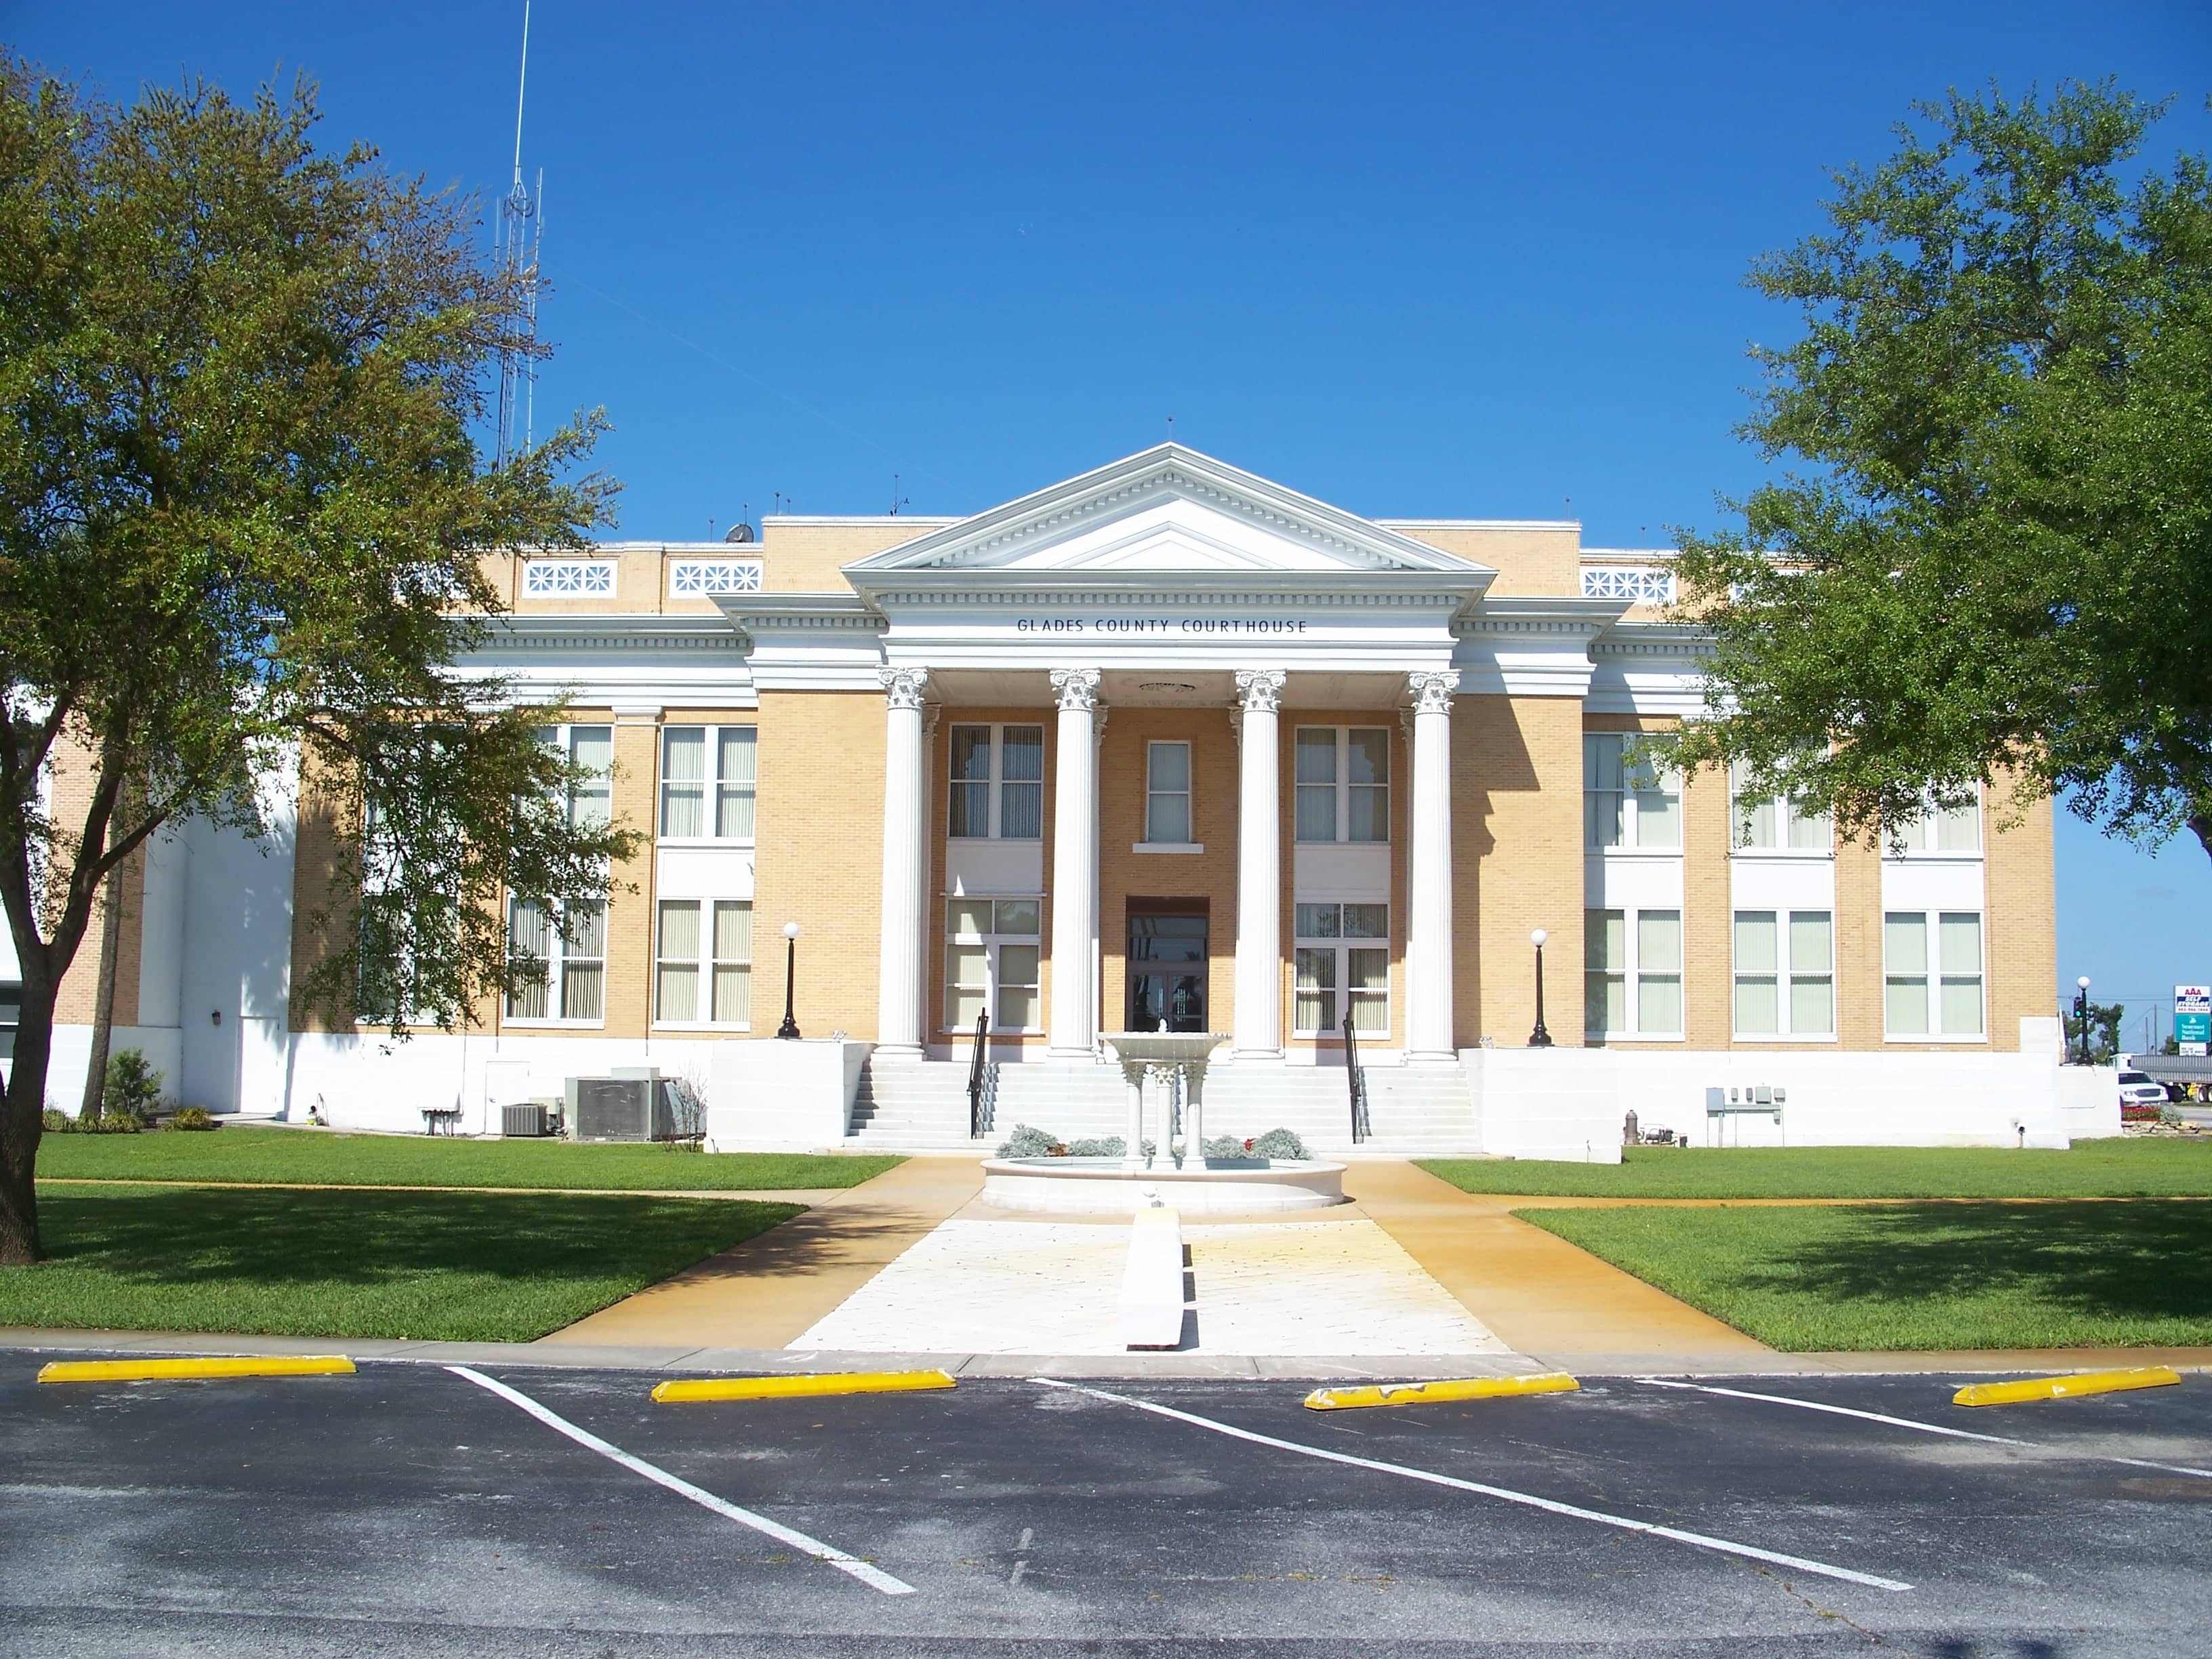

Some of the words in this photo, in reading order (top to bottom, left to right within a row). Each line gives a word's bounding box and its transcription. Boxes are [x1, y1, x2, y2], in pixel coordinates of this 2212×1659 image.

[1017, 619, 1084, 632] GLADES
[1095, 619, 1169, 632] COUNTY
[1181, 619, 1307, 633] COURTHOUSE
